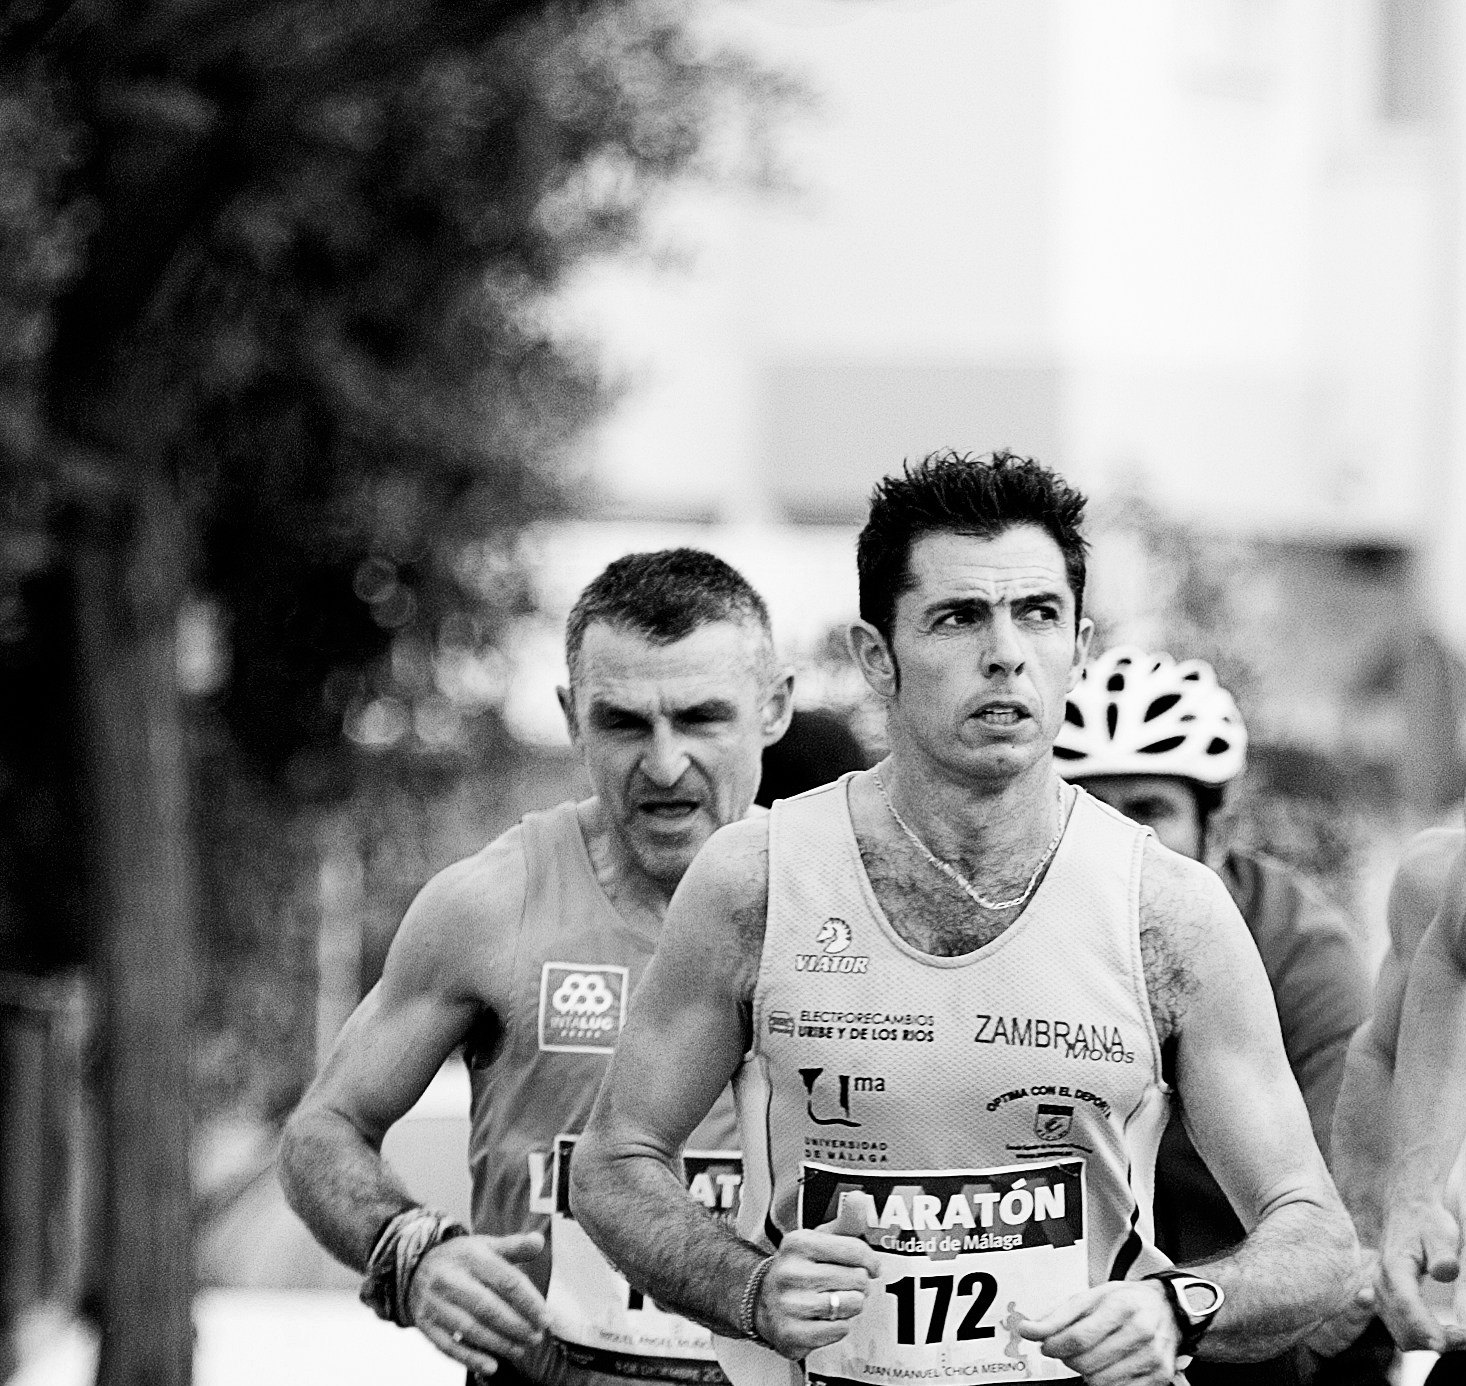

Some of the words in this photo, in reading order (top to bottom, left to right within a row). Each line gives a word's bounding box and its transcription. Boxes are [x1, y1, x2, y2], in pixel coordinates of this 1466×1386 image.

[795, 953, 870, 974] VIATOR
[800, 1010, 935, 1026] ELECTRORECAMBIOS
[798, 1026, 834, 1039] URIBE
[838, 1027, 847, 1039] Y
[850, 1028, 868, 1040] DE
[872, 1028, 898, 1041] LOS
[902, 1029, 934, 1042] RIOS
[974, 1014, 1125, 1054] ZAMBRANA
[1031, 1086, 1056, 1096] CON
[1059, 1086, 1072, 1097] EL
[804, 1137, 888, 1151] UNIVERSIDAD
[804, 1149, 821, 1159] DE
[879, 1234, 937, 1252] Ciudad
[939, 1235, 961, 1251] de
[963, 1232, 1023, 1251] Málaga
[885, 1271, 998, 1345] 172
[862, 1363, 891, 1376] JUAN
[892, 1366, 940, 1379] MANUEL
[944, 1364, 979, 1377] CHICA
[981, 1360, 1026, 1374] MERINO
